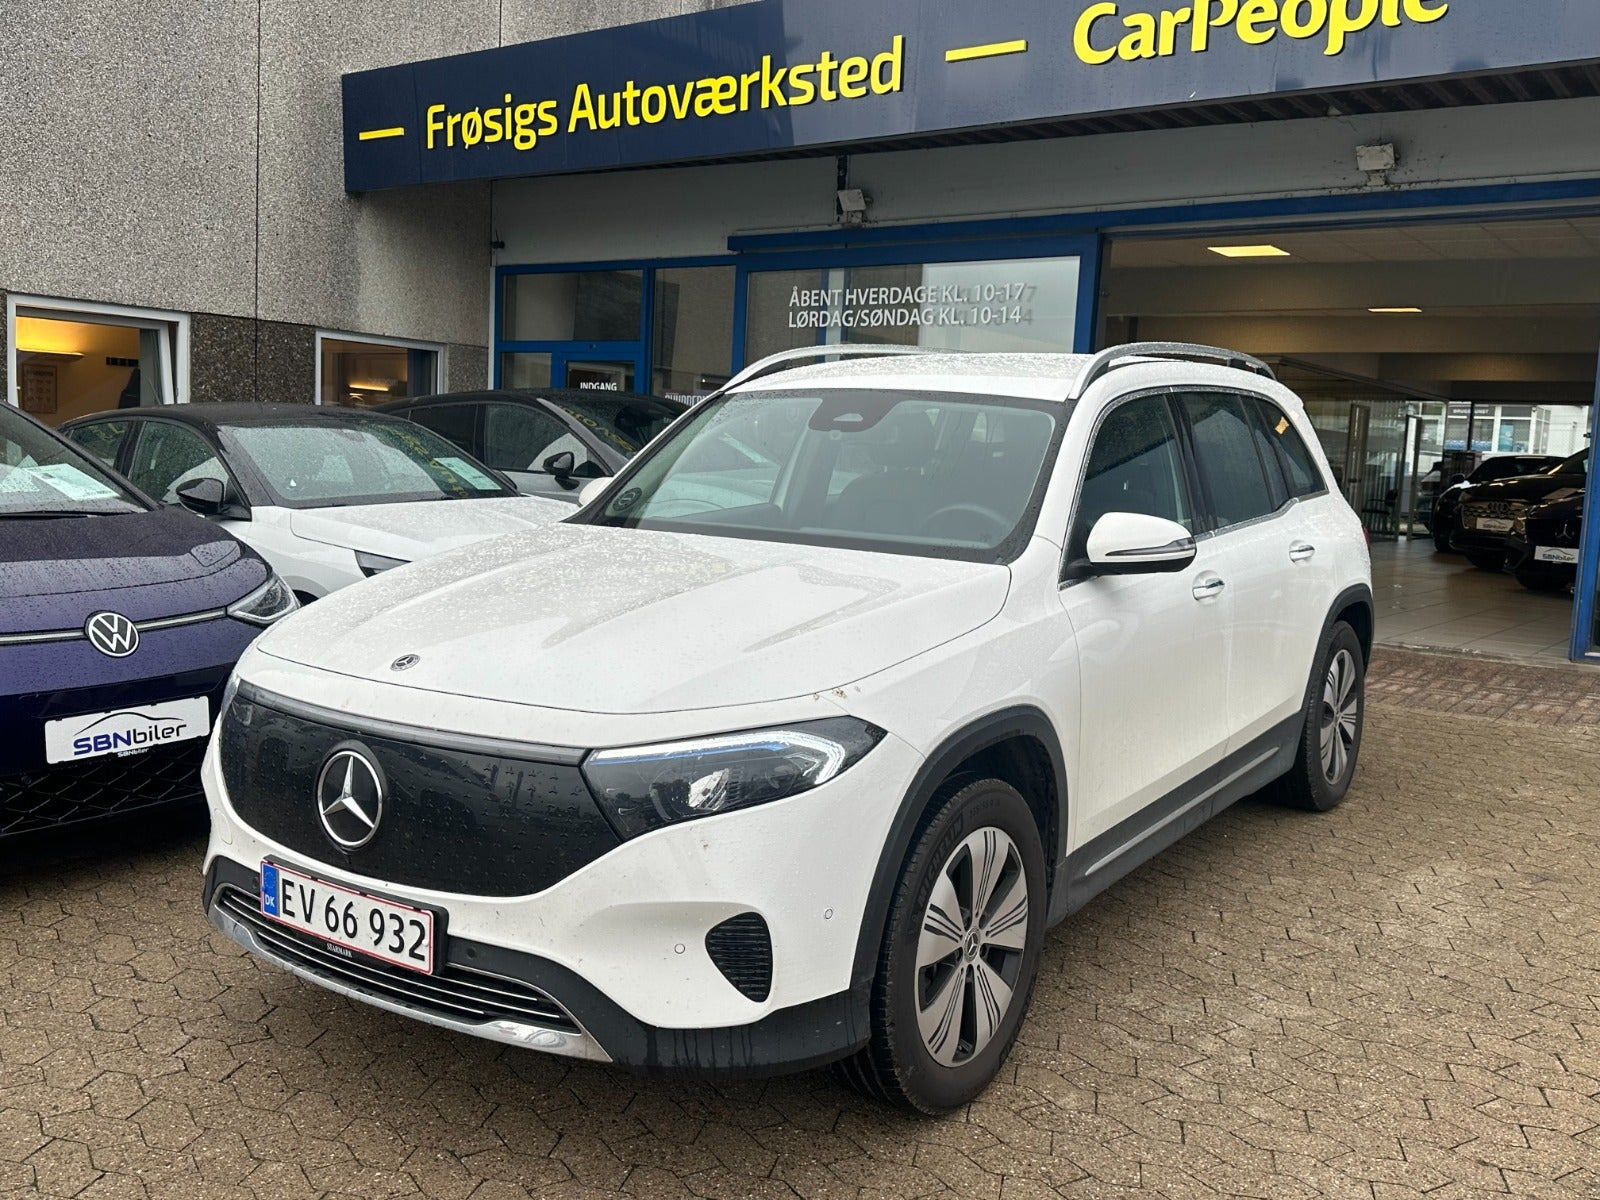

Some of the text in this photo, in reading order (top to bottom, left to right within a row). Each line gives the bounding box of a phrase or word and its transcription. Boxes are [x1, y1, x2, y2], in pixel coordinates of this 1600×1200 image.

[426, 35, 903, 150] Frøsigs Autoværksted
[789, 282, 1024, 307] ÅBENT HVERDAGE KL. 10-17
[788, 305, 1022, 328] LØRDAG/SØNDAG KL. 10-14
[73, 724, 187, 756] SBNbiler
[265, 894, 275, 907] DK
[282, 878, 426, 962] EV 66 932
